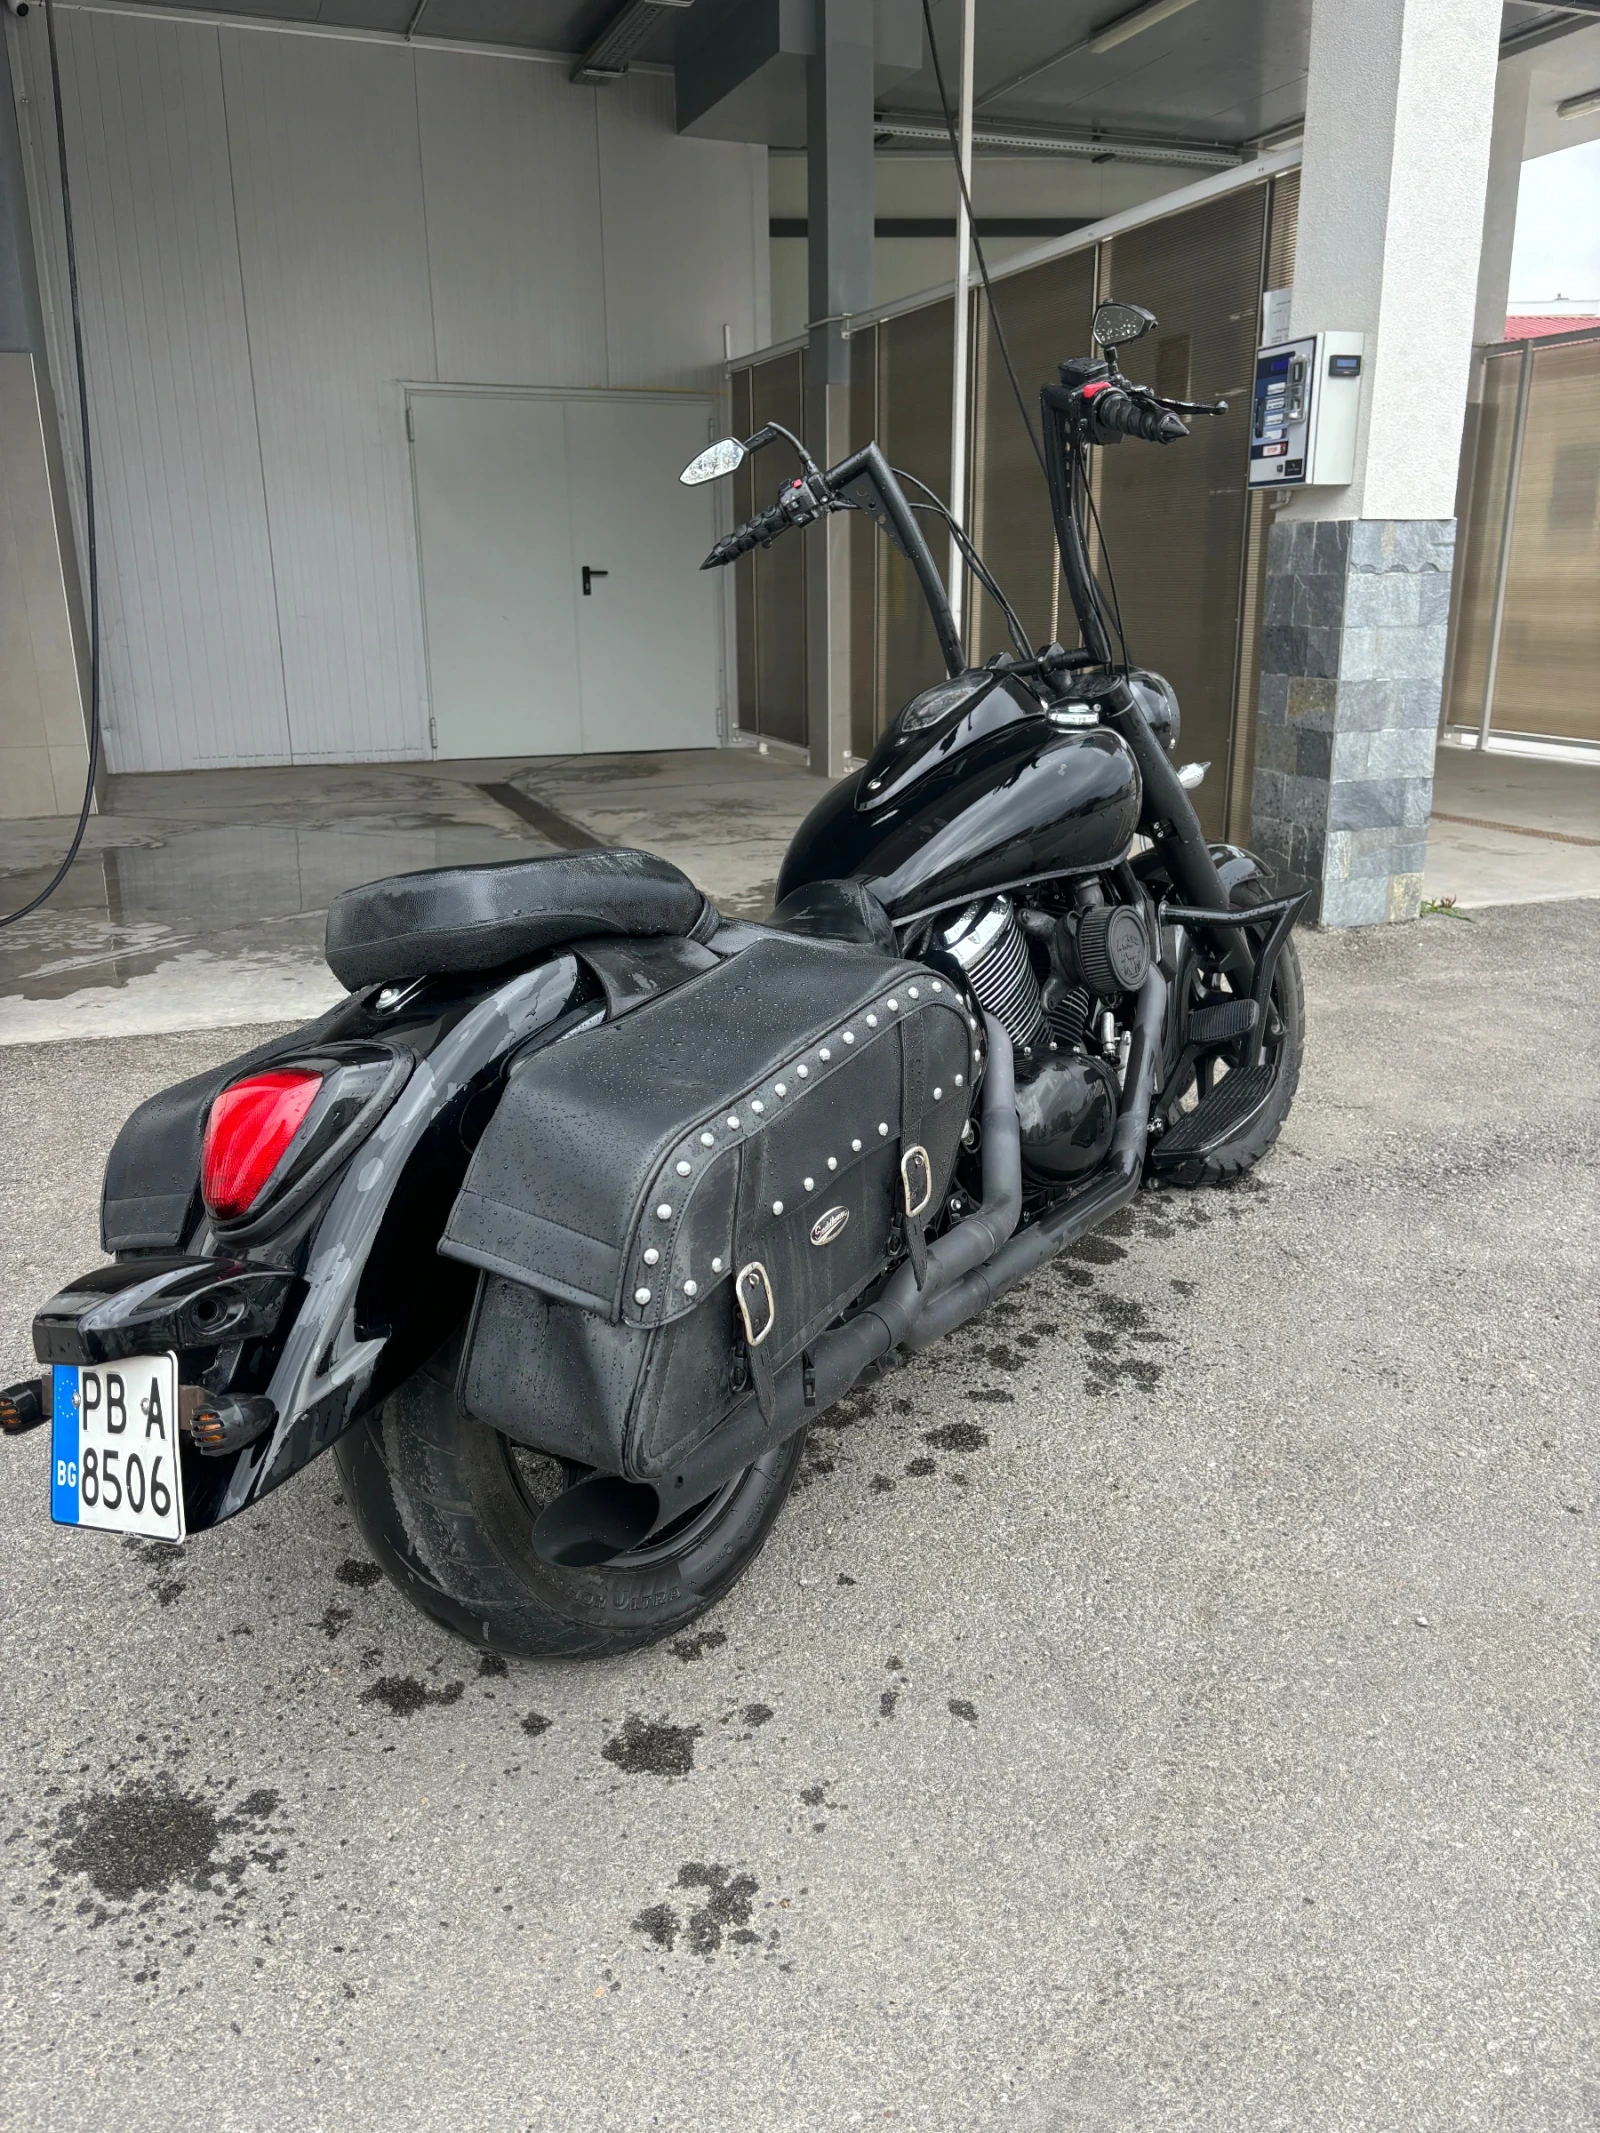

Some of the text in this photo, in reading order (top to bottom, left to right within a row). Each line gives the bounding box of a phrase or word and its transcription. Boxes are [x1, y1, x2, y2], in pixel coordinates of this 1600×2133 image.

[82, 1372, 167, 1440] PB A
[57, 1459, 77, 1487] BG
[82, 1447, 171, 1517] 8506
